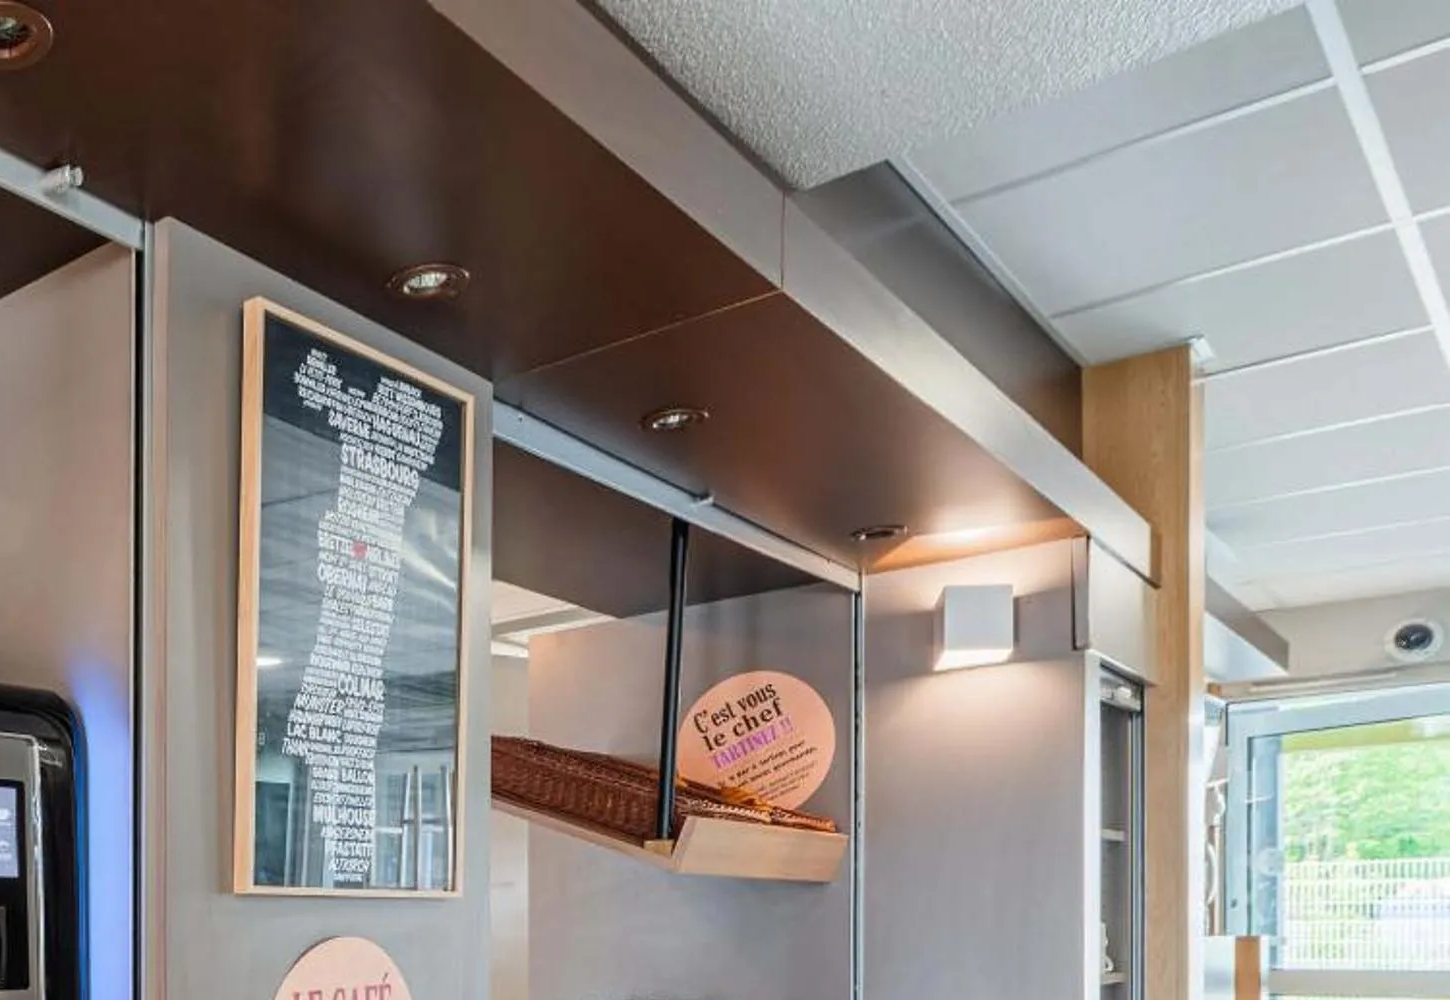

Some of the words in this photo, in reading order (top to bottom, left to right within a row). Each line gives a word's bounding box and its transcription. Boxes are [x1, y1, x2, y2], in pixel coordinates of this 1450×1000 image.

[693, 703, 737, 734] C'est
[737, 683, 778, 712] vous
[703, 732, 728, 751] le
[732, 697, 785, 738] chef
